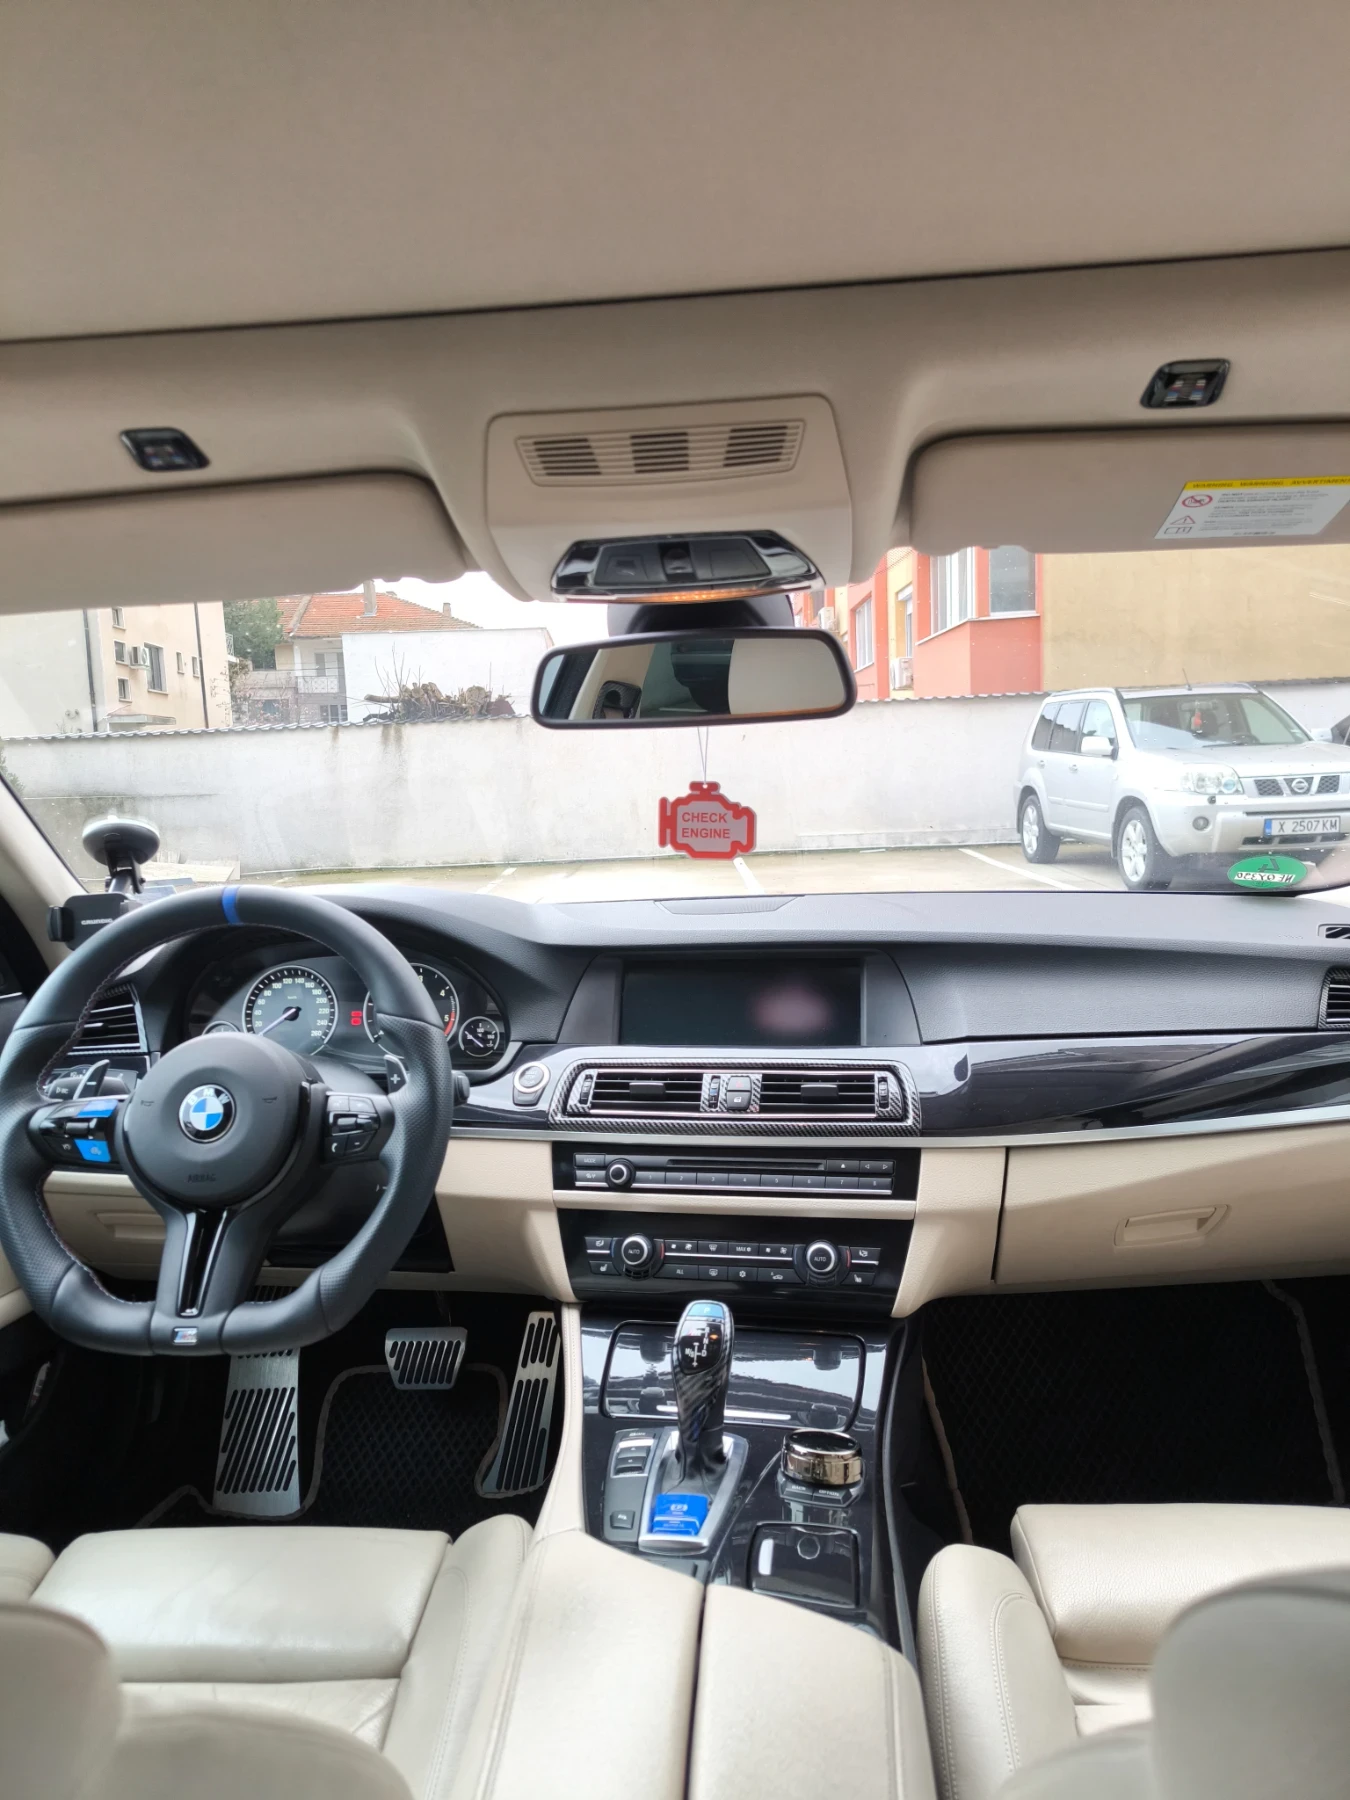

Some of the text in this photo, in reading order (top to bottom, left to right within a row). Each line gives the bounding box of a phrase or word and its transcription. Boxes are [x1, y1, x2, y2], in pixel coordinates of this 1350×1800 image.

[682, 812, 728, 823] CHECK
[1278, 819, 1337, 833] X 2507 KM
[682, 828, 731, 839] ENGINE
[440, 989, 446, 997] 4
[444, 1014, 449, 1022] 5
[187, 1087, 231, 1106] BMW
[818, 1489, 840, 1497] OPTION
